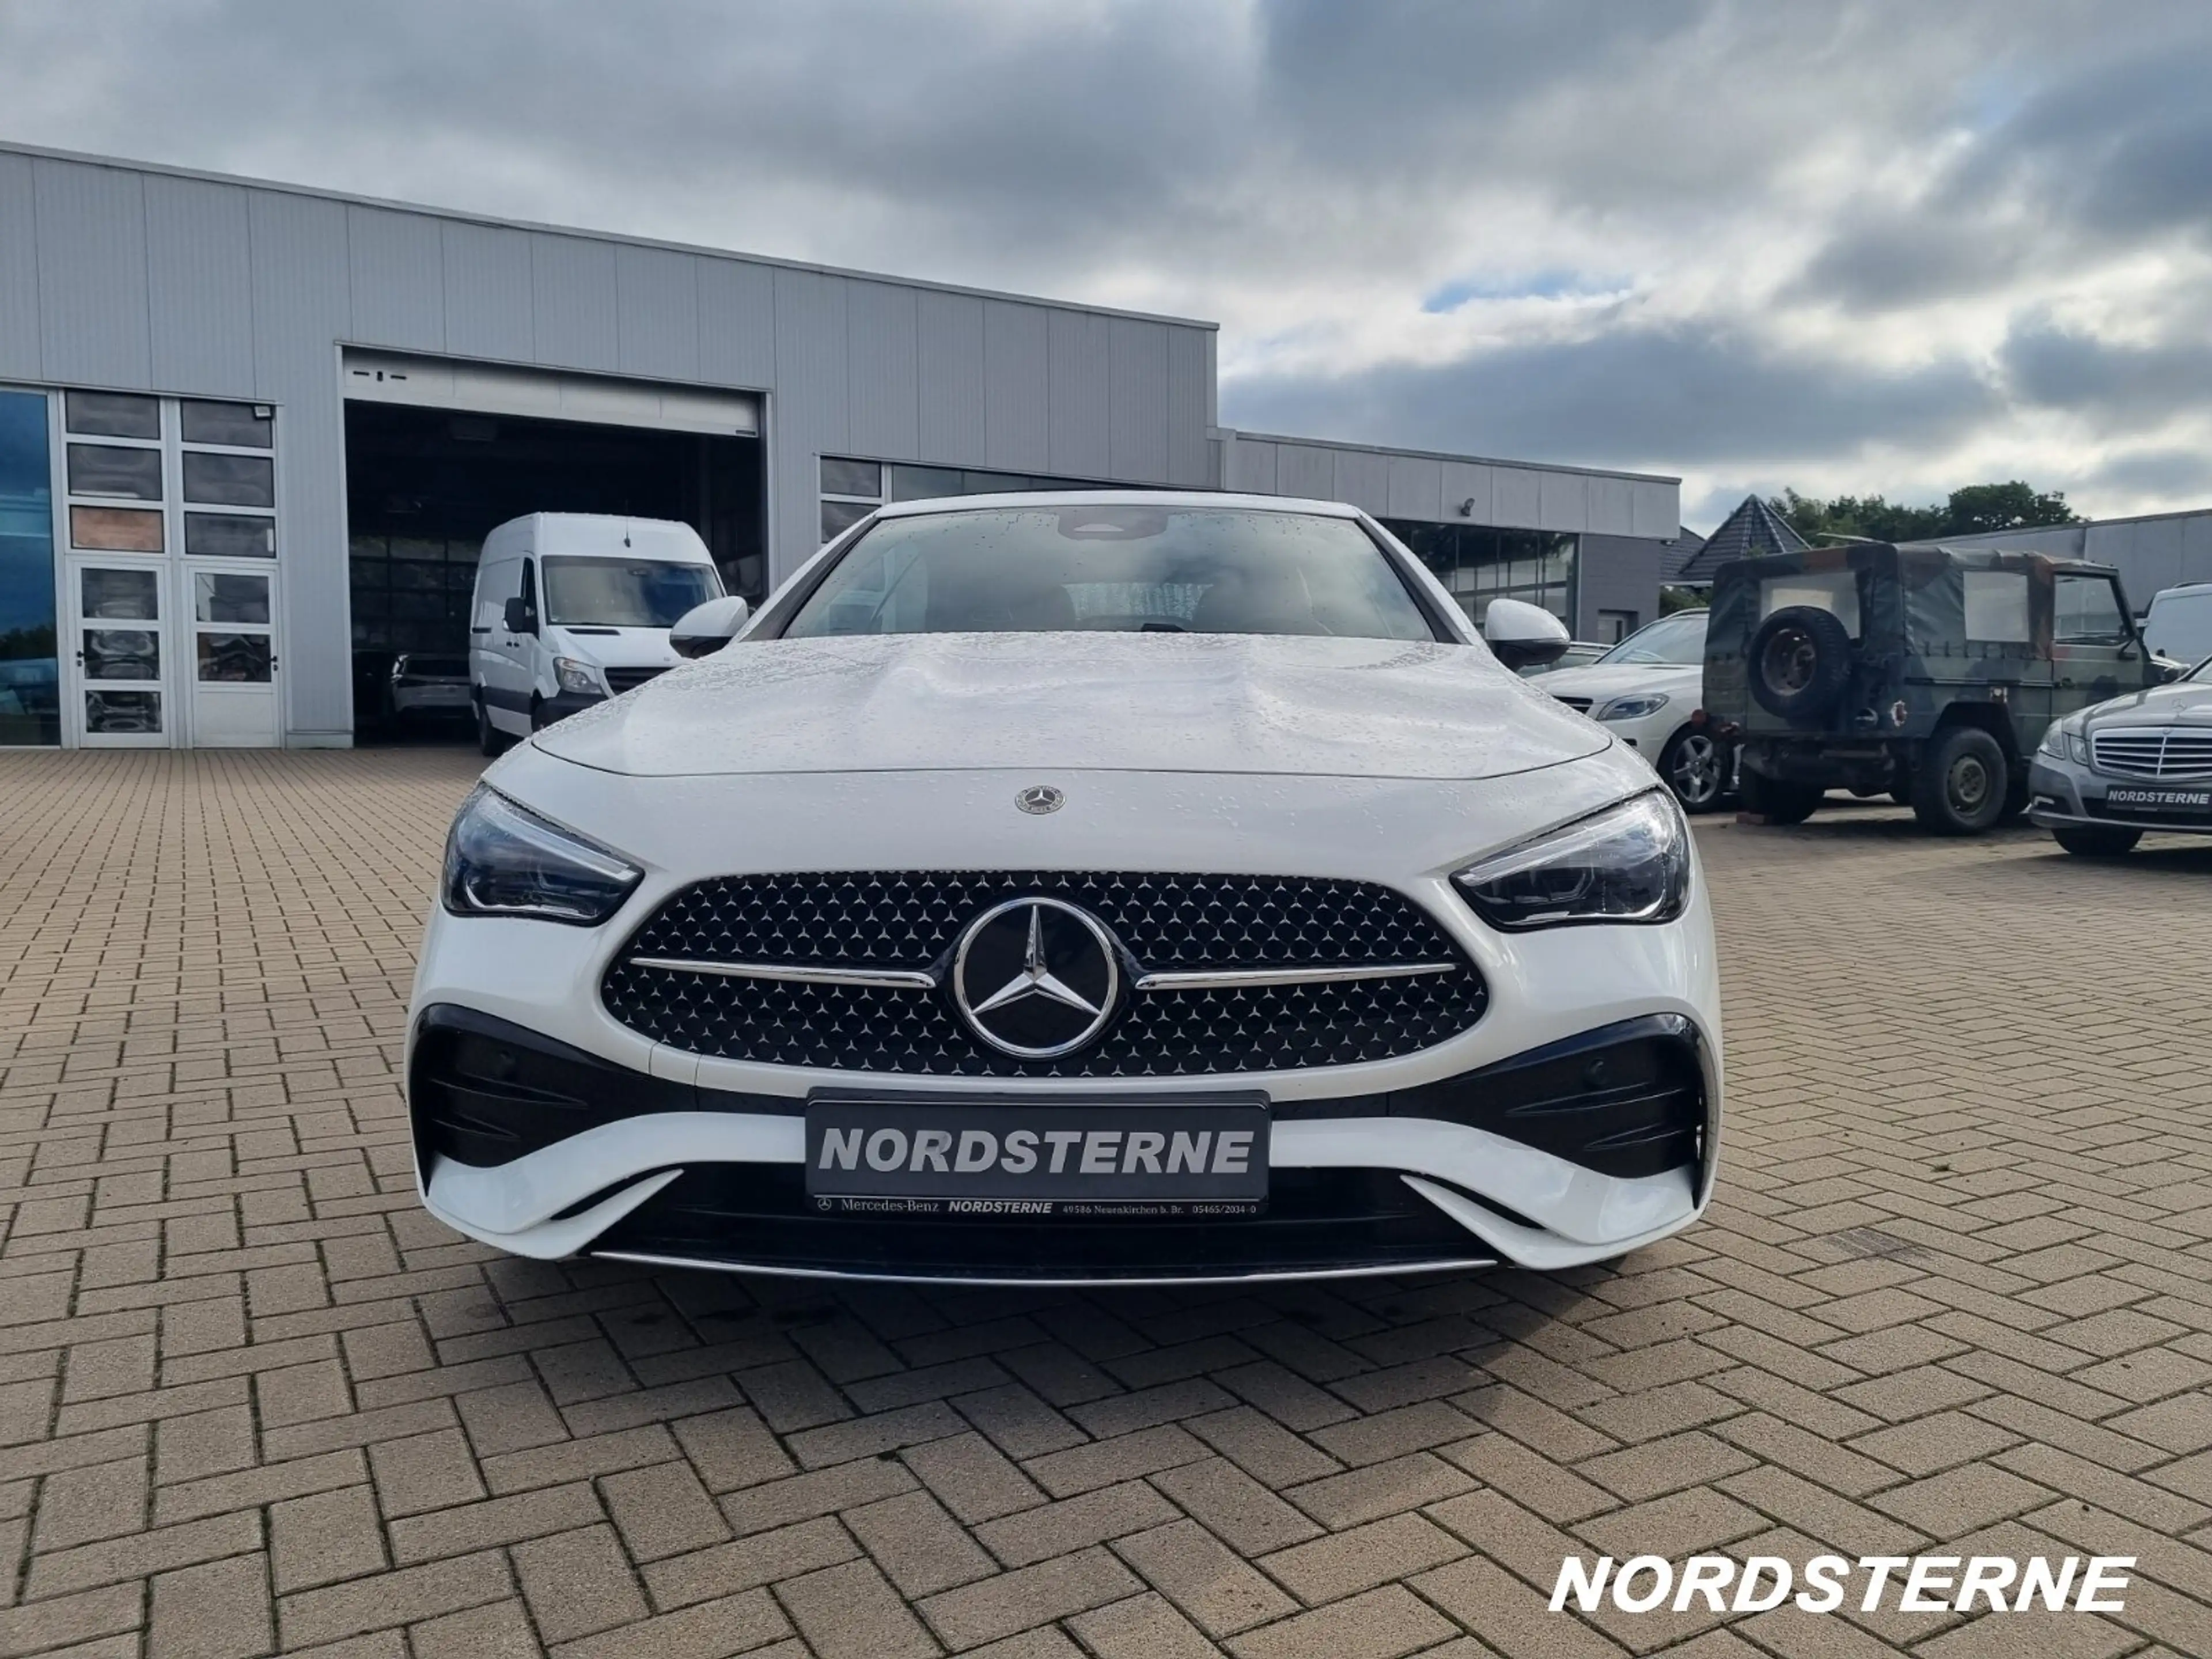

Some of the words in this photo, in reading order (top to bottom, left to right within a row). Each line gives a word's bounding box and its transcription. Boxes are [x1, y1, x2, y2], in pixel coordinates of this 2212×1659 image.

[2108, 790, 2211, 805] NORDSTERNE
[819, 1127, 1255, 1174] NORDSTERNE
[841, 1198, 940, 1212] Mercedes-Benz
[948, 1200, 1053, 1214] NORDSTERNE
